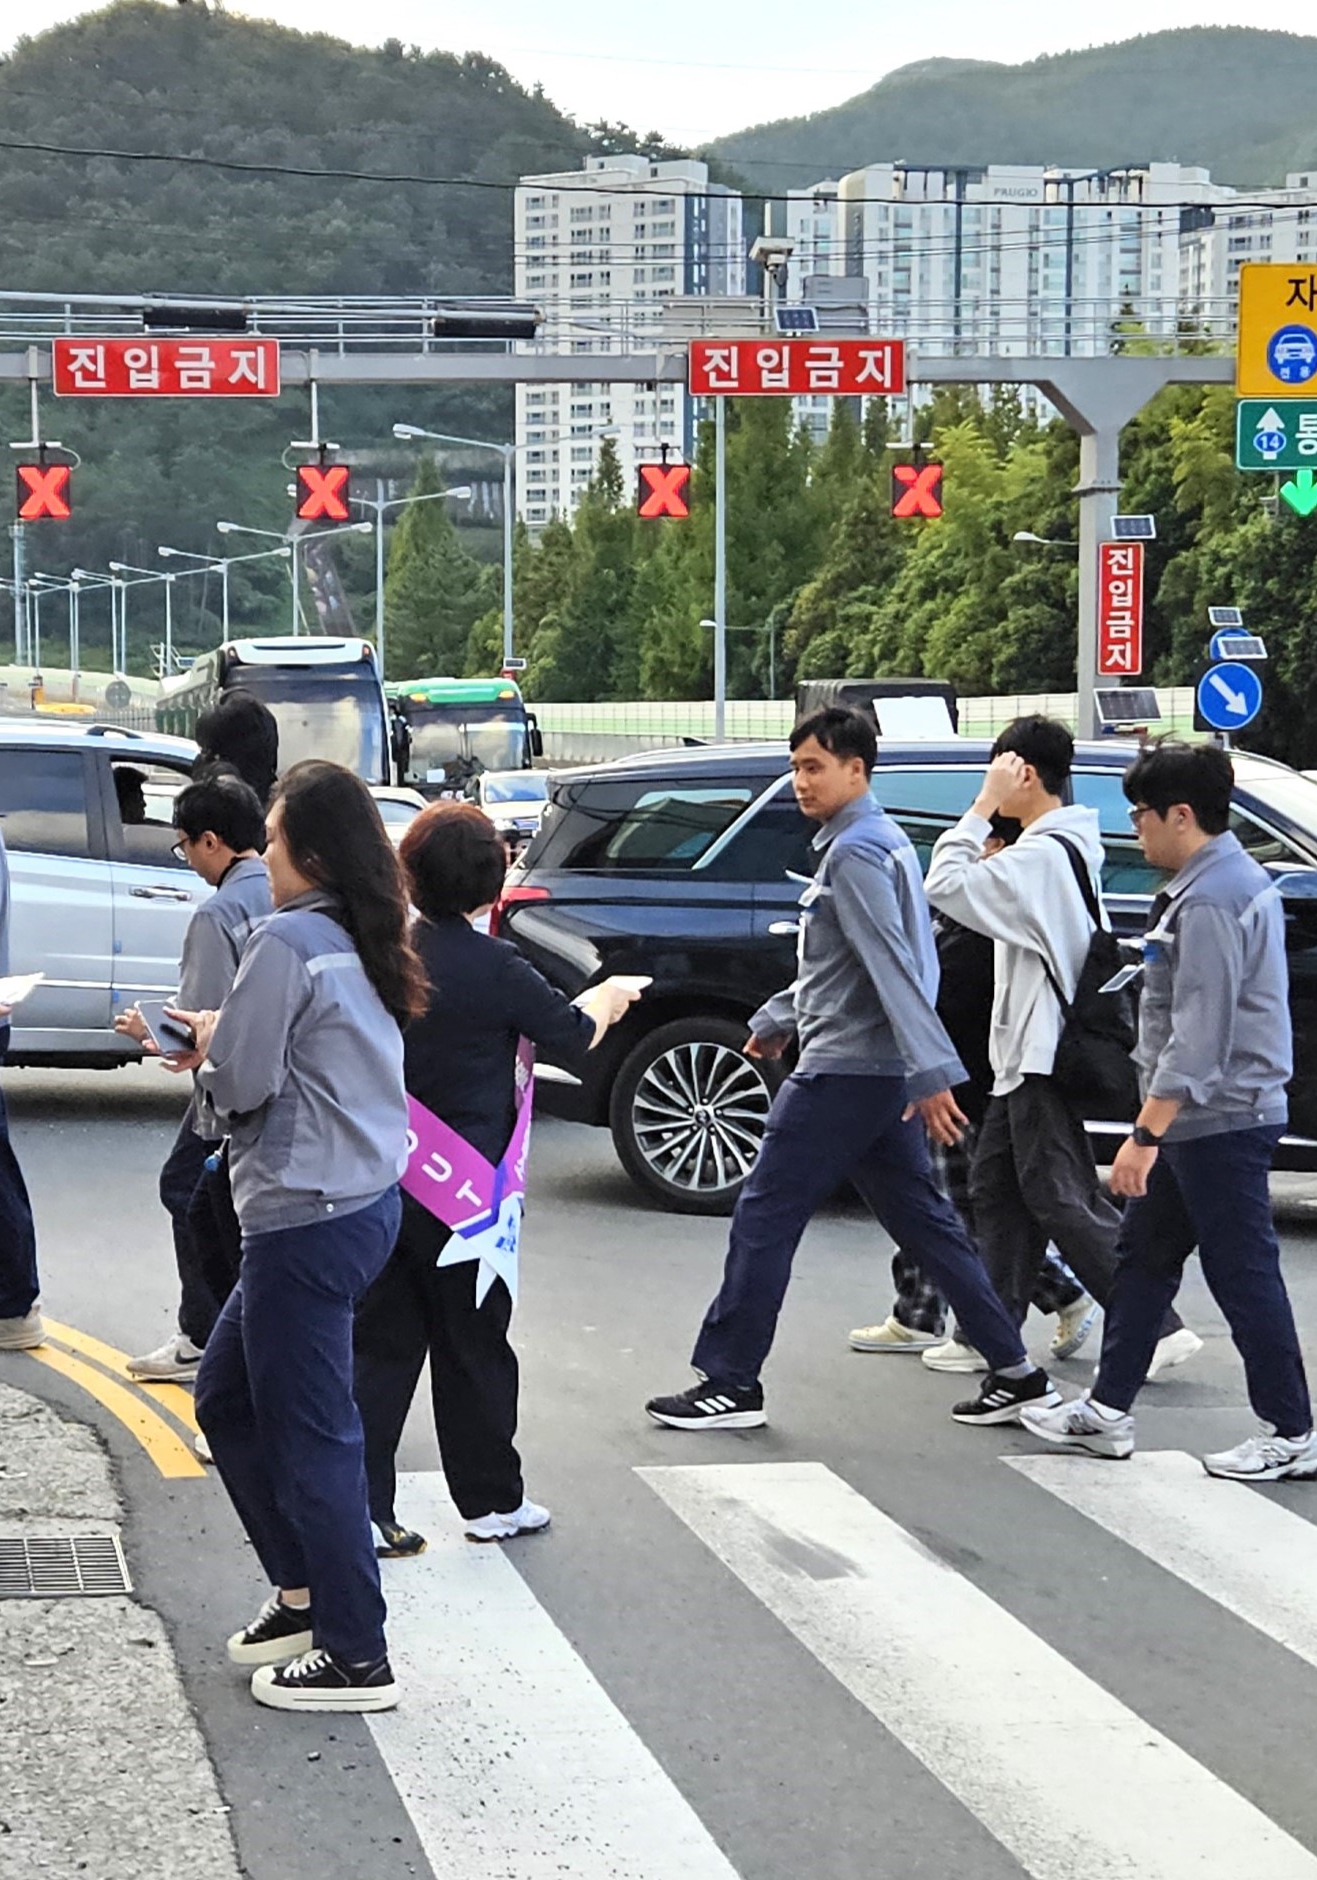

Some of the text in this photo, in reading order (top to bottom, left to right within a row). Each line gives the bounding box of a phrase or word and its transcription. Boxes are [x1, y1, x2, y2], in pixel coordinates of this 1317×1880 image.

[67, 345, 265, 389] 진입금지
[702, 345, 892, 389] 진입금지
[1259, 434, 1281, 450] 14
[1105, 548, 1135, 671] 진입금지
